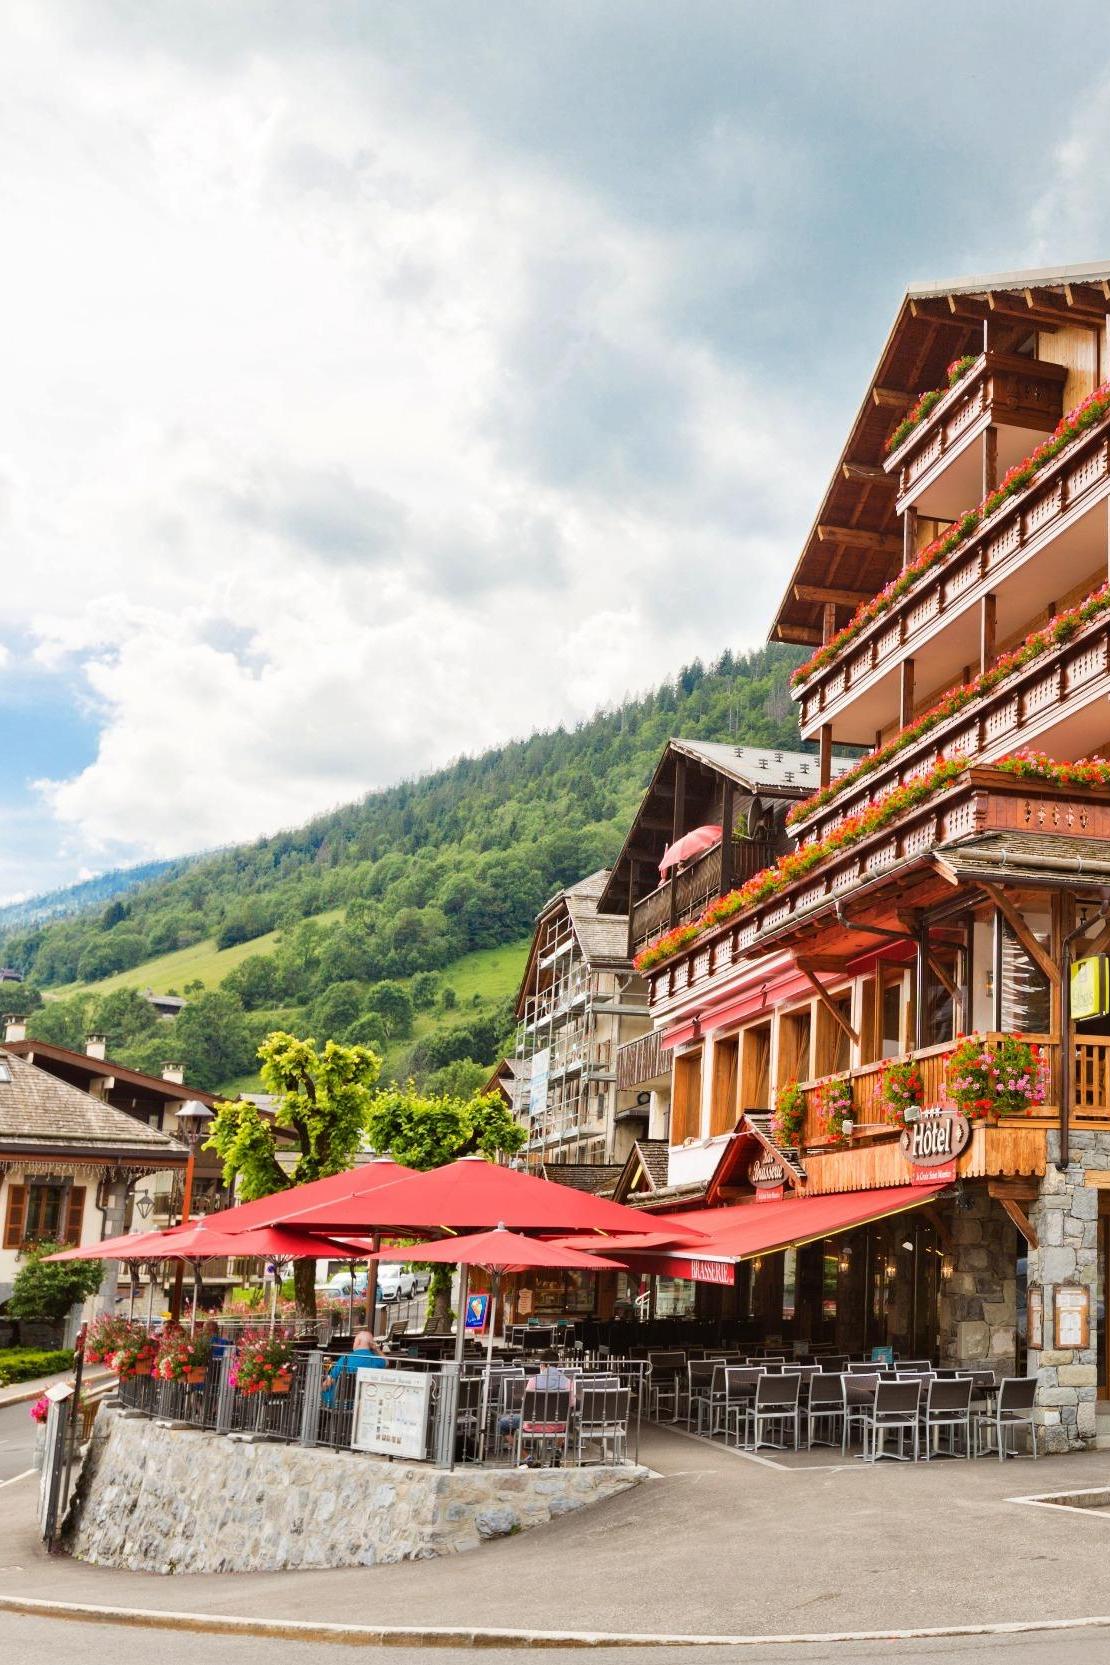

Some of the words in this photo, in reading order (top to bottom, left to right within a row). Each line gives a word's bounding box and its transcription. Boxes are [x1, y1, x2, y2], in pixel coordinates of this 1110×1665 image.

[912, 1118, 951, 1156] Hôtel
[752, 1160, 783, 1182] Brasserie
[691, 1260, 729, 1282] BRASSERIE
